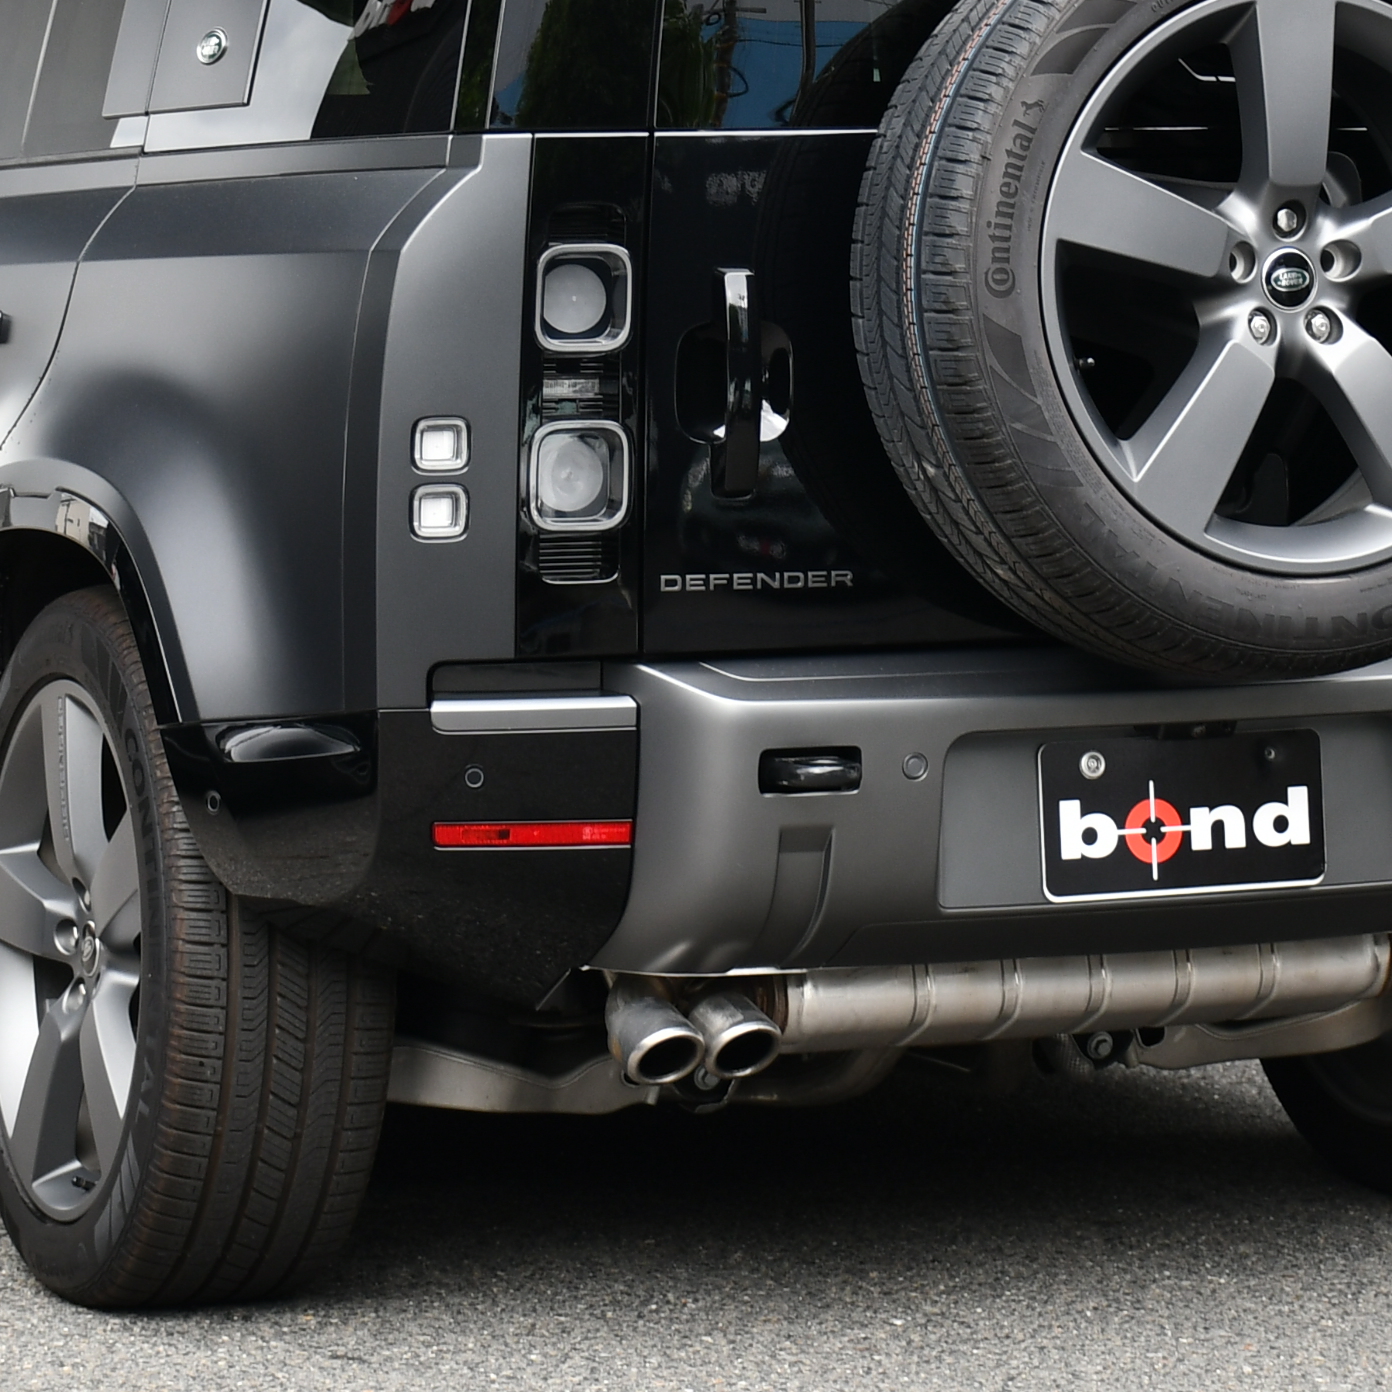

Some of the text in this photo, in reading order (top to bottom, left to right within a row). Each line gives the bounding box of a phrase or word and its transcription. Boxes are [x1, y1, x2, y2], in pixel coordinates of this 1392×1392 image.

[984, 119, 1038, 299] Continental
[660, 570, 854, 592] DEFENDER
[1058, 785, 1311, 861] bond
